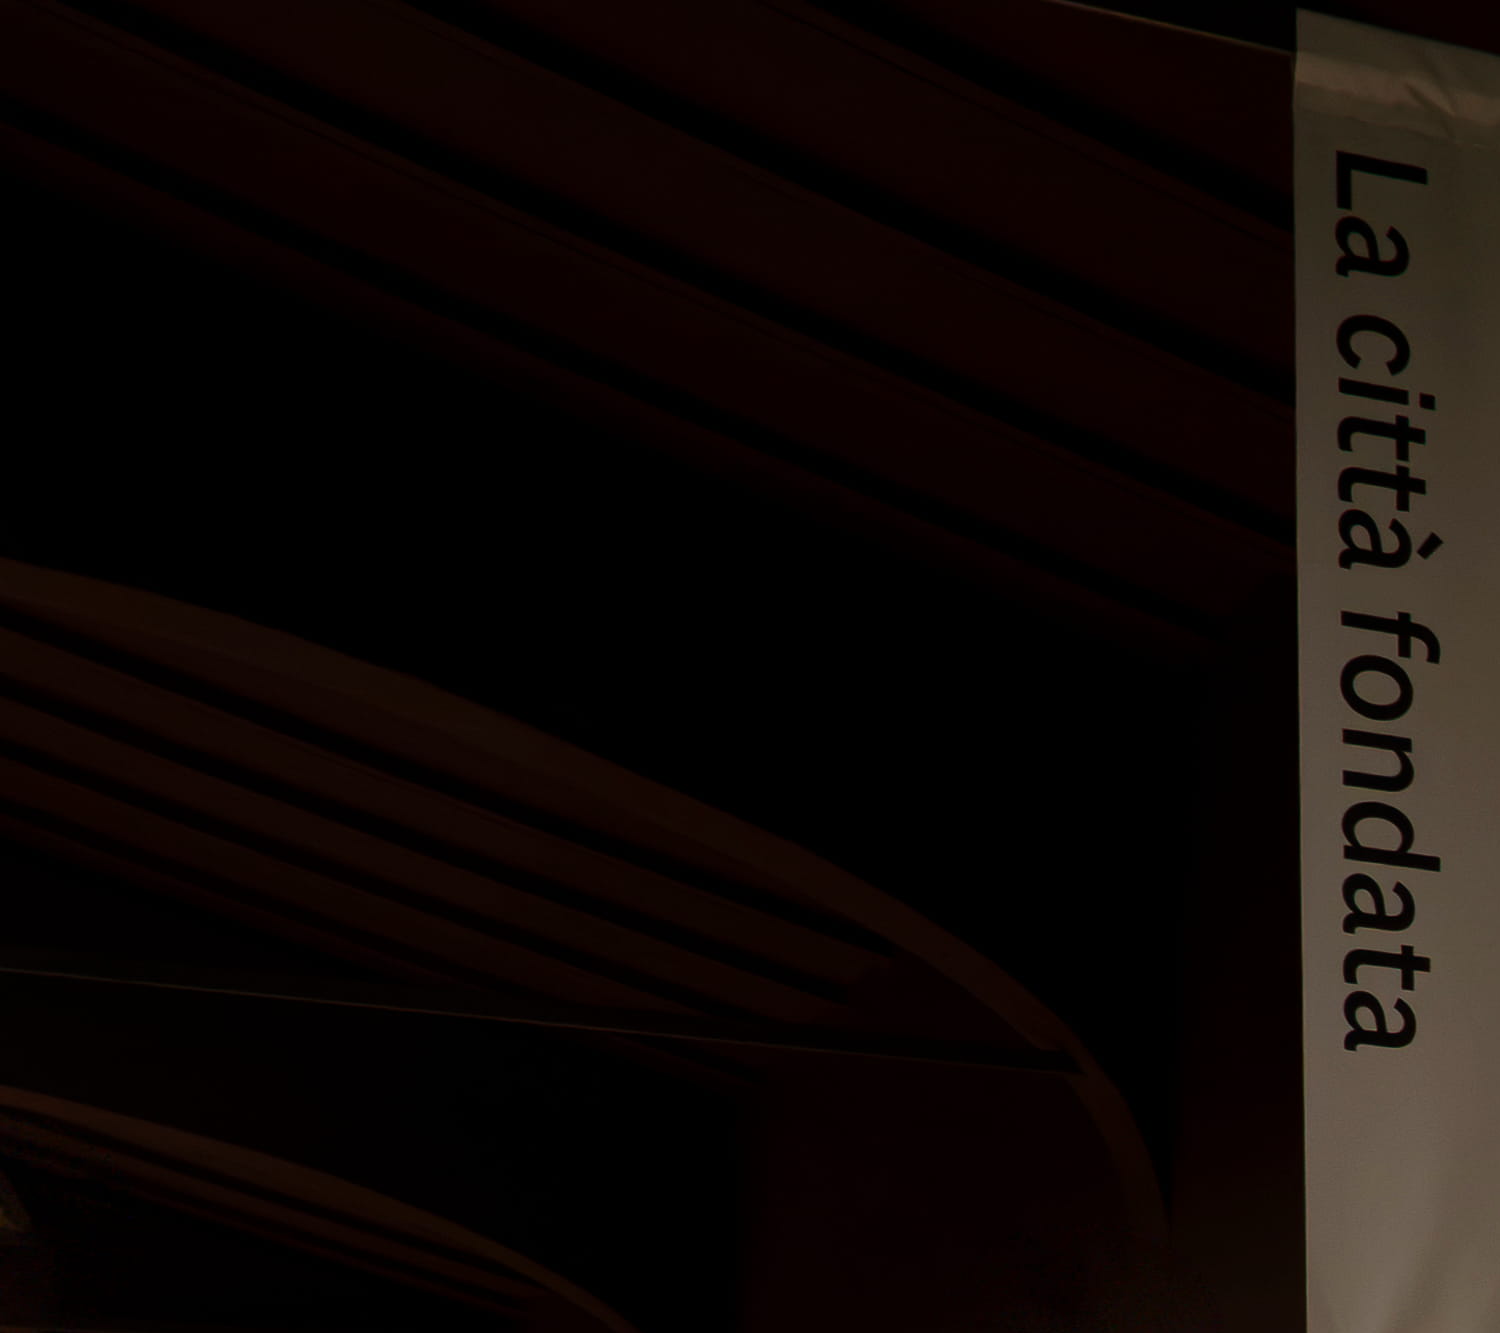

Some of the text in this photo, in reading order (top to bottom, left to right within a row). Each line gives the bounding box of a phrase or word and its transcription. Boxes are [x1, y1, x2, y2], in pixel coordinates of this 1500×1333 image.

[1335, 149, 1443, 1054] La città fondata
